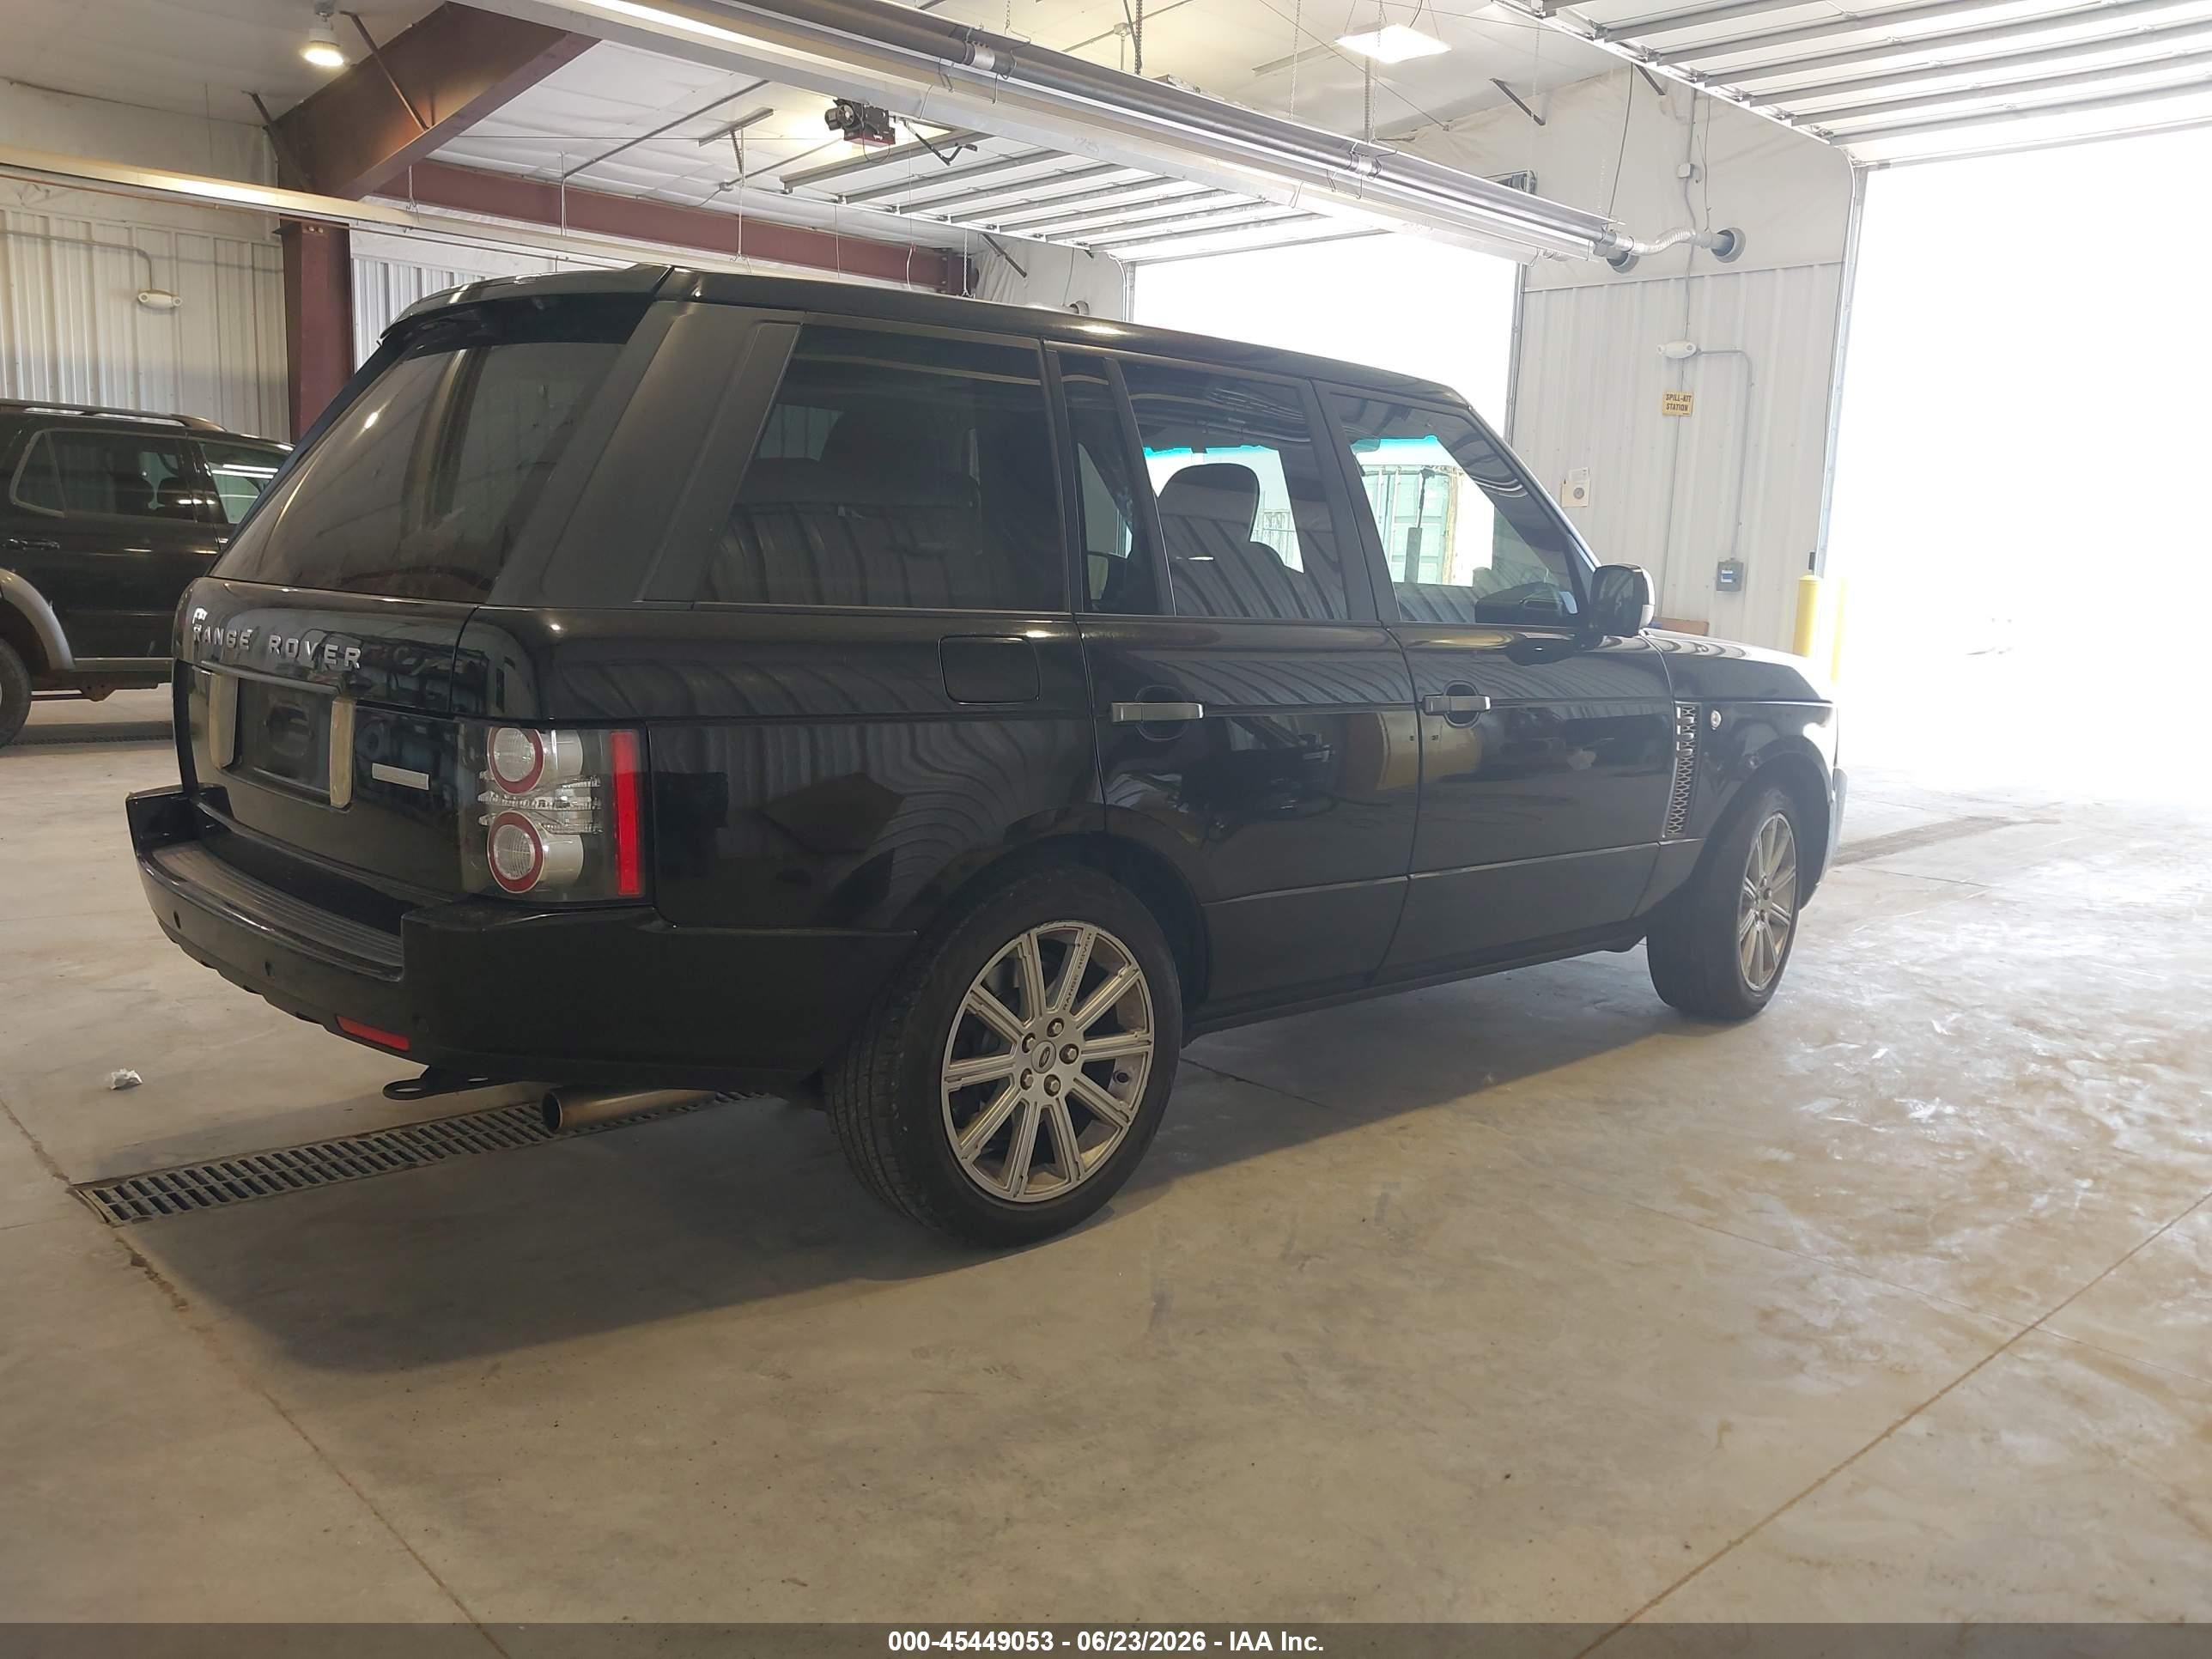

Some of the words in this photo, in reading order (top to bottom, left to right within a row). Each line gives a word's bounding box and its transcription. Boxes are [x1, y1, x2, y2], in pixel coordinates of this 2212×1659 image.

[1666, 393, 1692, 403] SPILL-KIT
[1666, 403, 1689, 411] STATION
[192, 623, 252, 650] RANGE
[268, 635, 361, 670] ROVER
